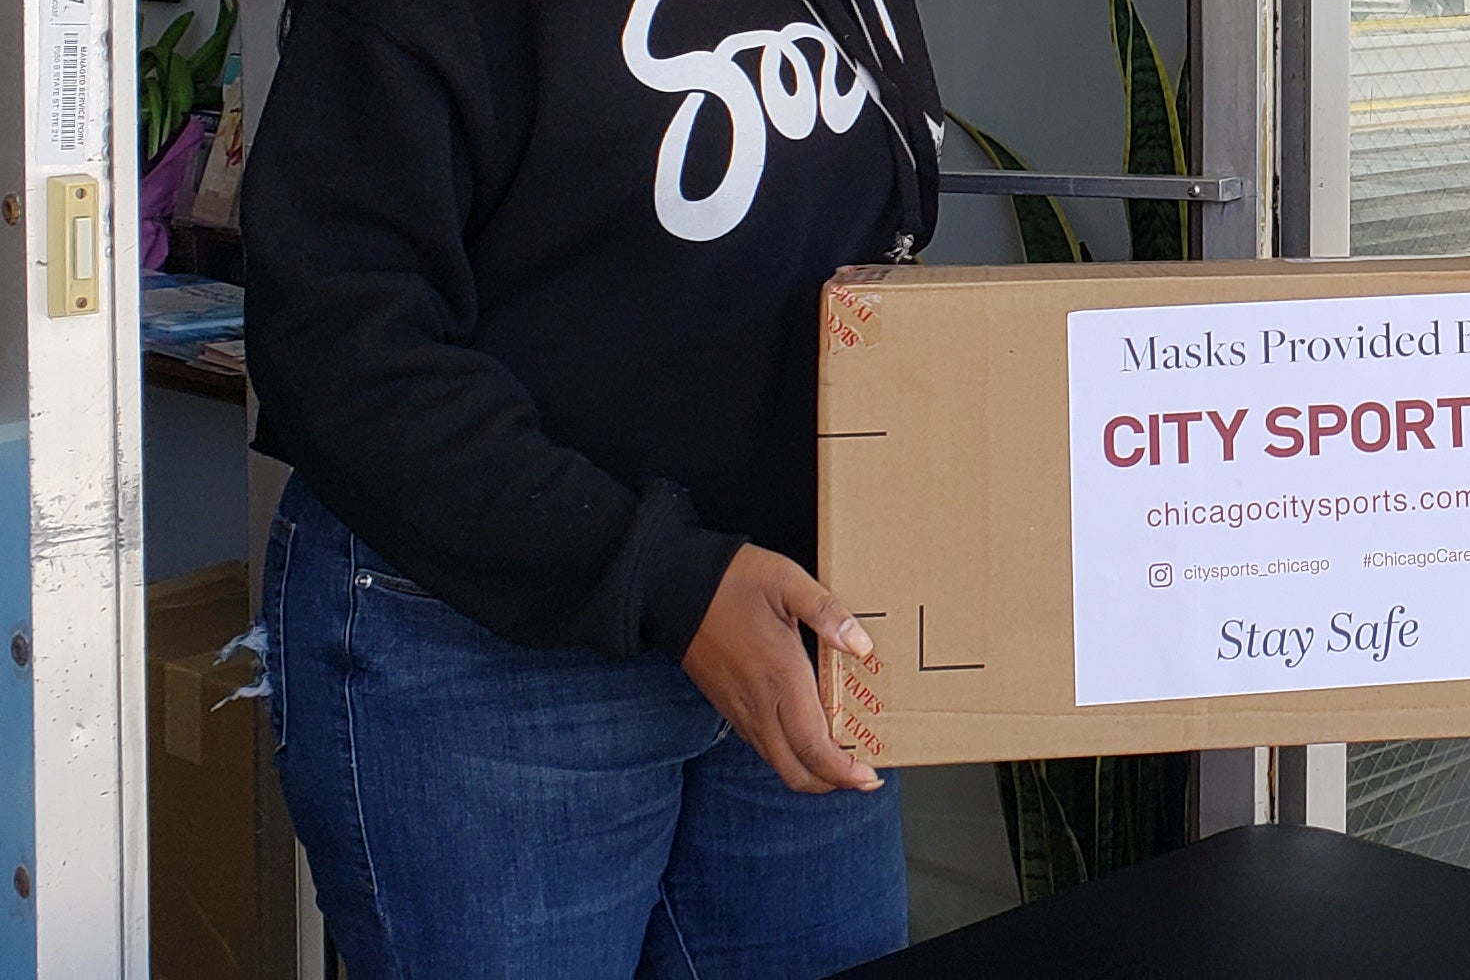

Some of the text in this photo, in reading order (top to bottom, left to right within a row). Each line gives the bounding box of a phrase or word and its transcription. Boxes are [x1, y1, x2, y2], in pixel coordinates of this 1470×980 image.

[77, 87, 86, 121] SERVICE
[76, 122, 85, 146] POINT
[1120, 331, 1247, 372] Masks
[1259, 319, 1442, 365] Provided
[1103, 408, 1249, 468] CITY
[1183, 557, 1331, 582] citysports_chicago
[1217, 605, 1420, 668] Stay Safe
[844, 672, 885, 715] TAPES
[844, 712, 885, 757] TAPES
